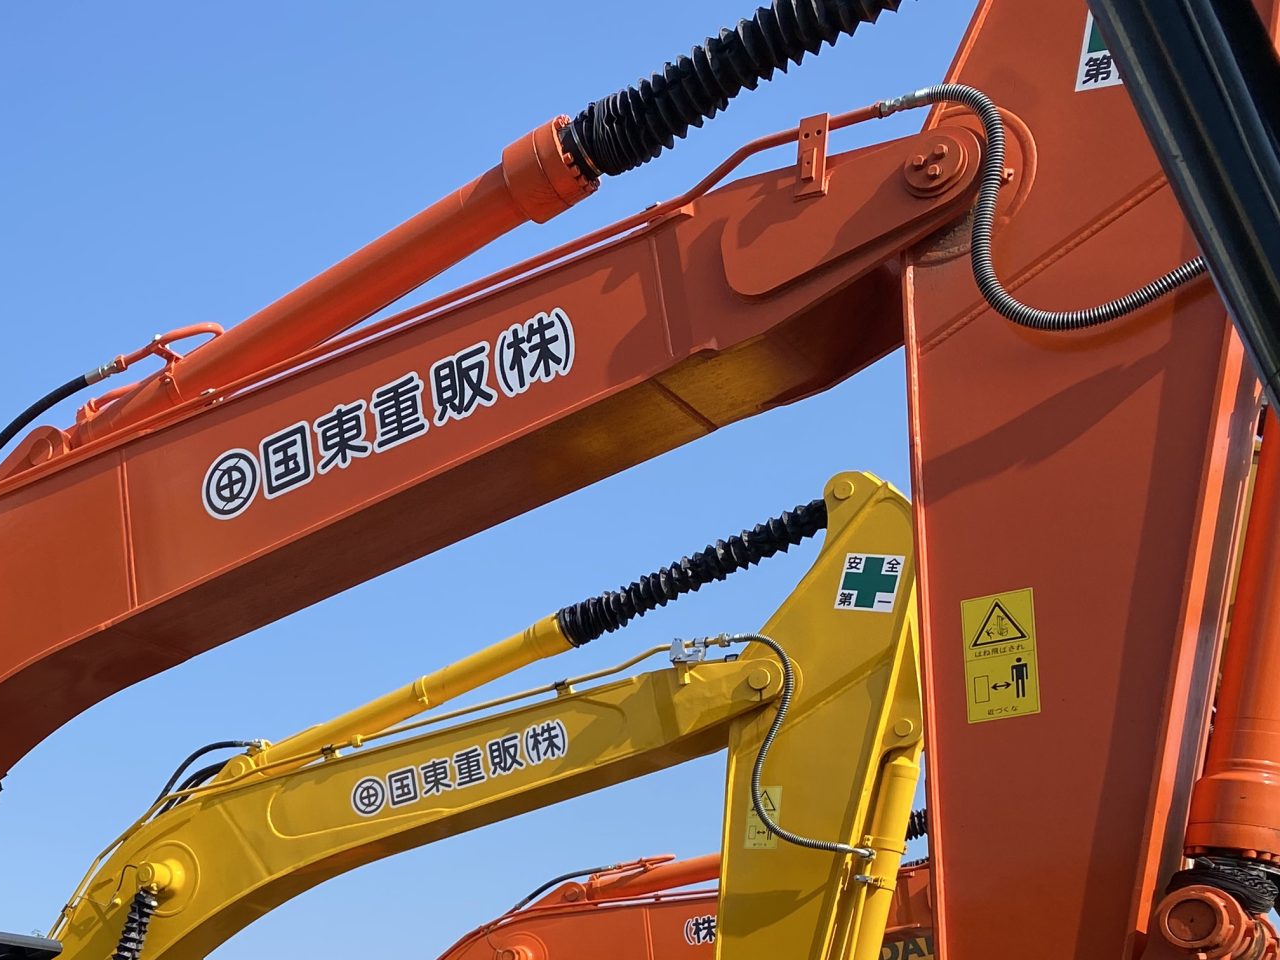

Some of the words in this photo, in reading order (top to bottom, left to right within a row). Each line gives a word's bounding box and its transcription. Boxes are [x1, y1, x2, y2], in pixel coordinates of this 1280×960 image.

[262, 308, 572, 496] 国東重販(株)
[388, 721, 567, 806] 国東重販(株)
